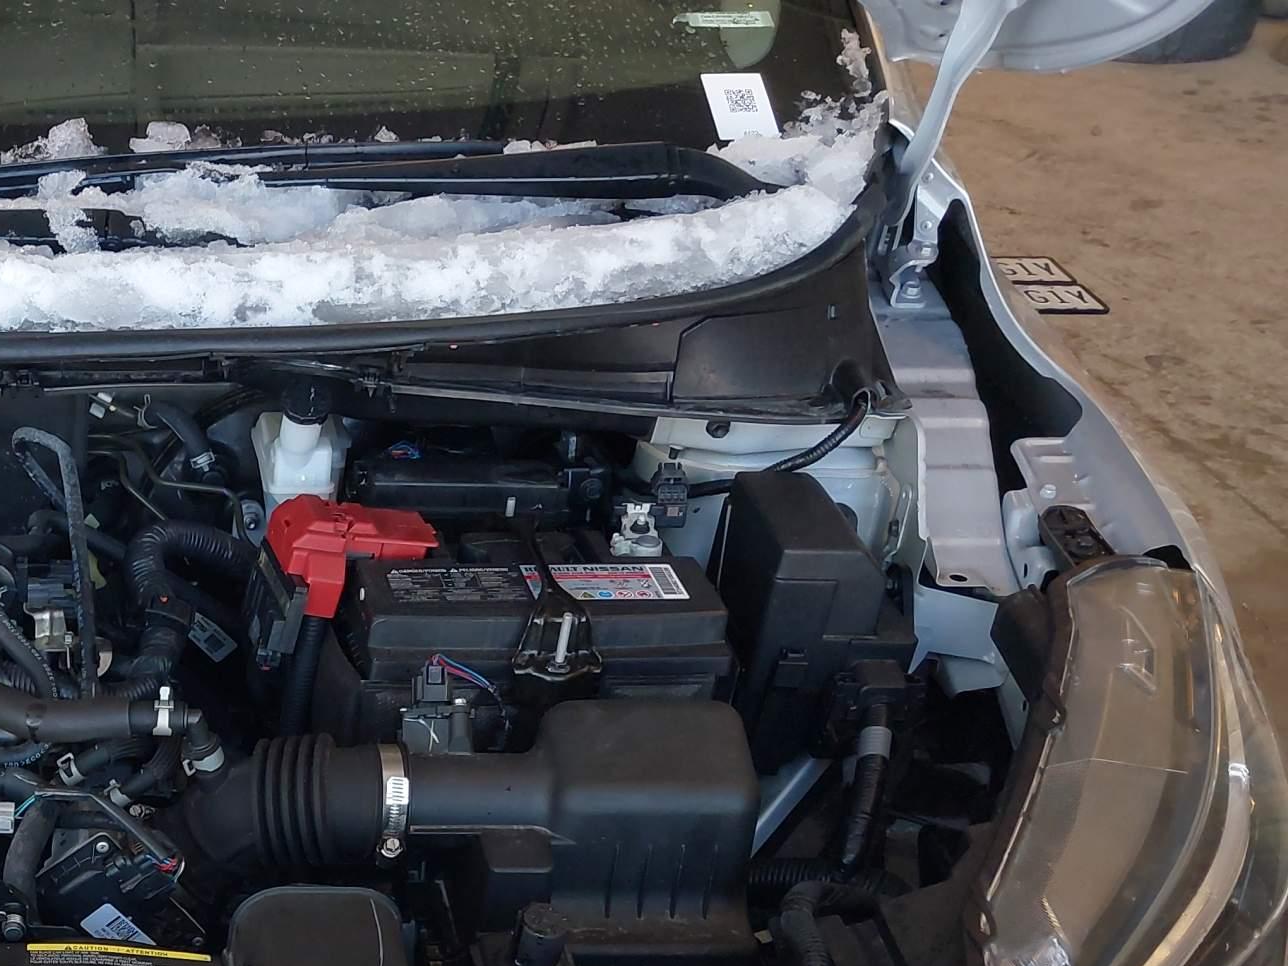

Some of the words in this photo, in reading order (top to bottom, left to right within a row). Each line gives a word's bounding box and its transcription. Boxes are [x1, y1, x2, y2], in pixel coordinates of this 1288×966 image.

[582, 564, 644, 573] NISSAN
[72, 944, 110, 952] CAUTION
[125, 948, 169, 957] ATTENTION
